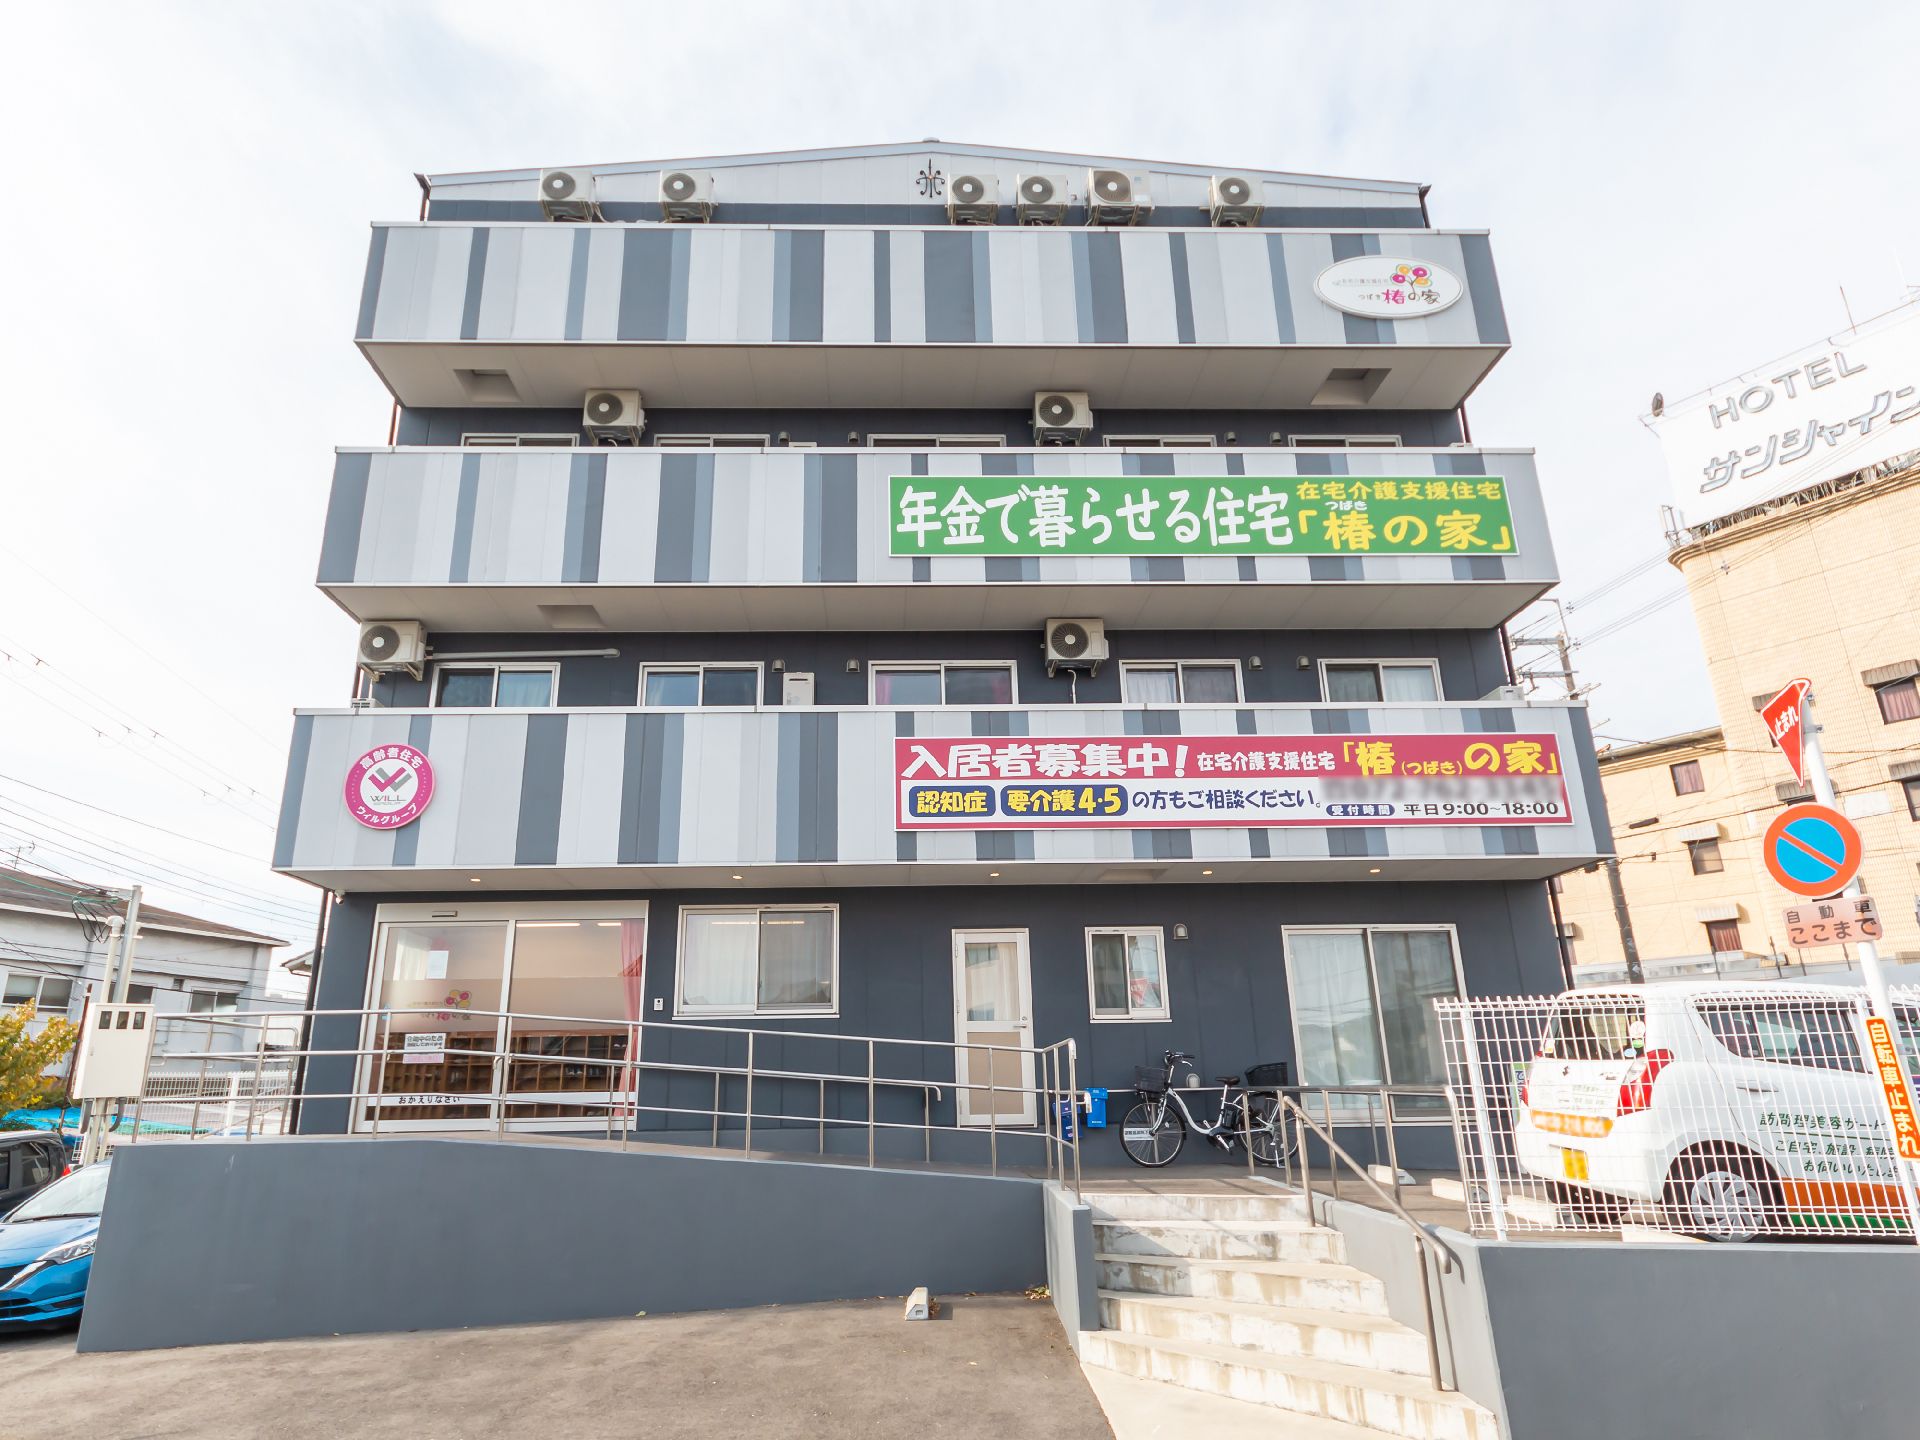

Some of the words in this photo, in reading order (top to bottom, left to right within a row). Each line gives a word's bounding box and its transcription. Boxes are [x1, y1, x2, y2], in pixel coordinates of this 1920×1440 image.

[1382, 289, 1440, 304] 椿の家
[1709, 352, 1868, 429] HOTEL
[1296, 481, 1502, 500] 在宅介護支援住宅
[896, 484, 1293, 548] 年金で暮らせる住宅
[1324, 501, 1368, 511] つばき
[1299, 510, 1514, 550] 「椿の家」
[1775, 705, 1799, 741] 止まれ
[1197, 751, 1335, 771] 在宅介護支援住宅
[916, 790, 987, 813] 認知症
[1331, 805, 1391, 816] 受付時間
[1786, 900, 1873, 924] 自動車
[1790, 918, 1877, 945] ここまで
[398, 1096, 461, 1105] おかえりなさい
[1869, 1022, 1920, 1156] 自転車止まれ
[1804, 1160, 1899, 1178] お伺いいたしま
